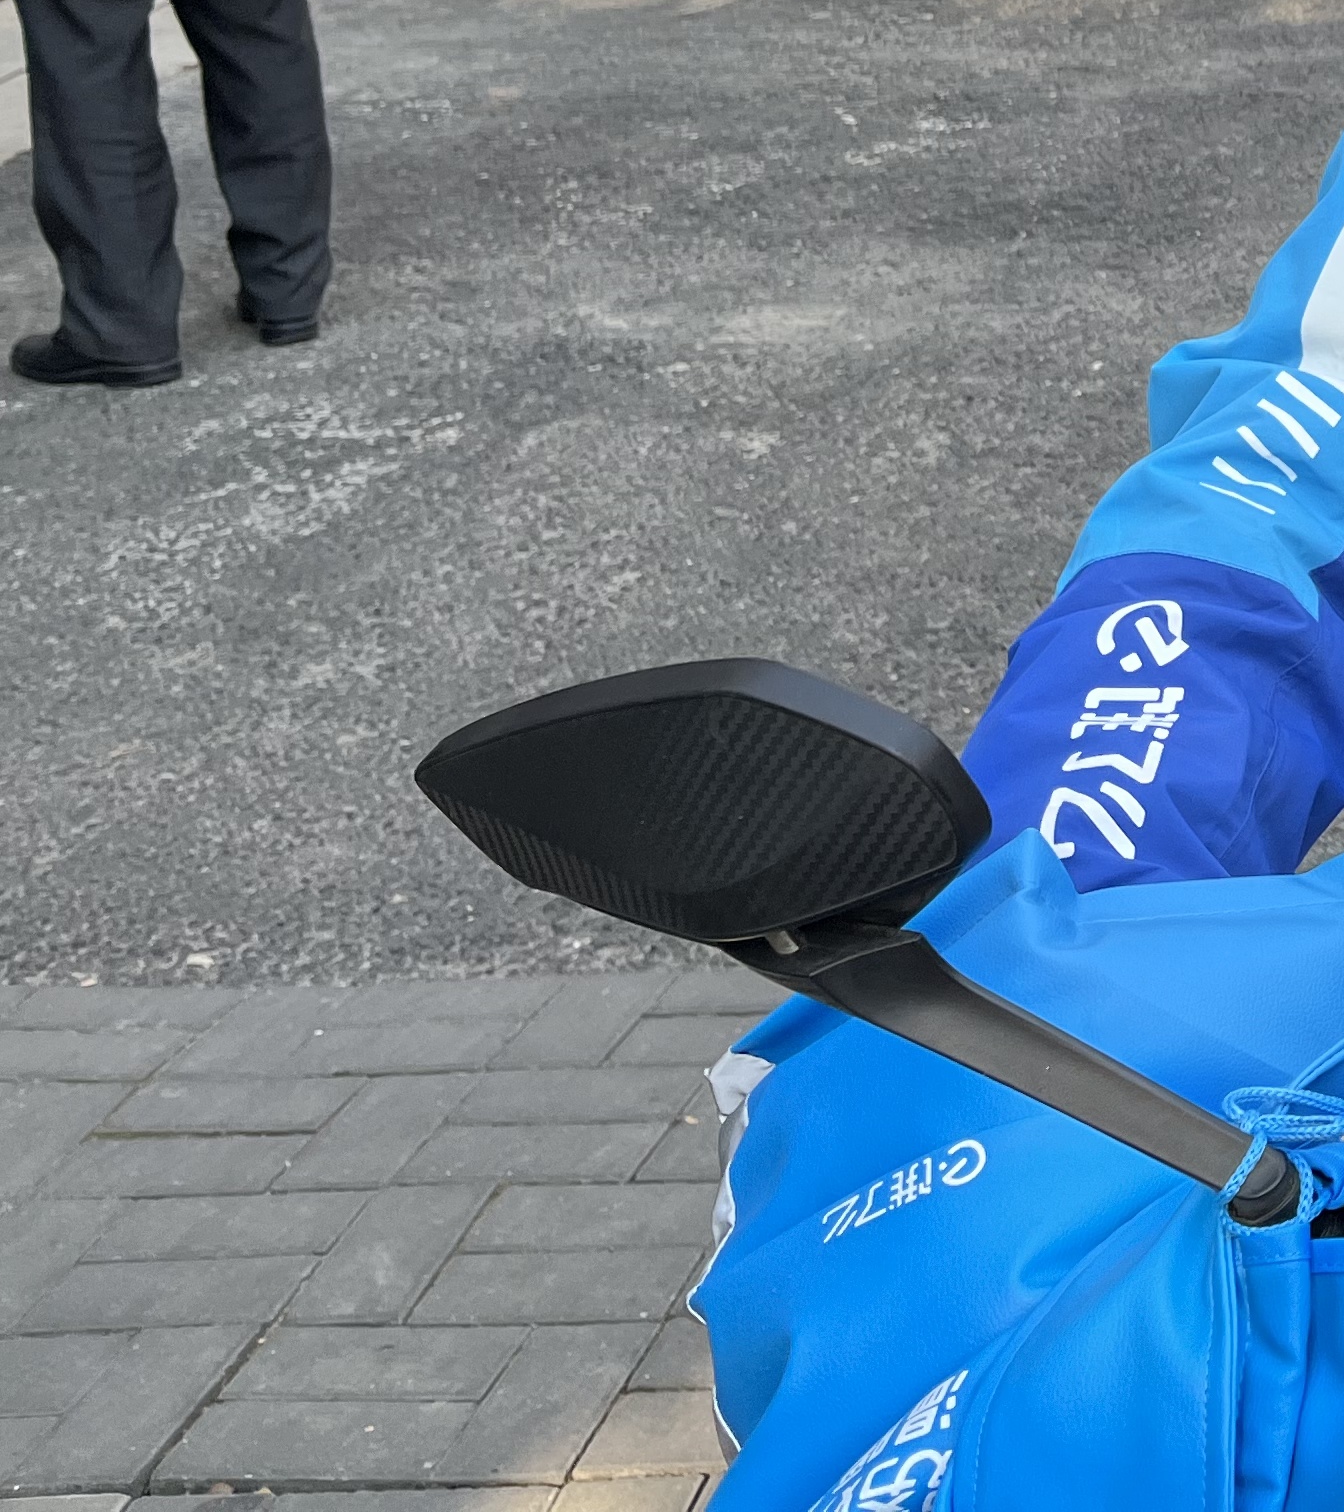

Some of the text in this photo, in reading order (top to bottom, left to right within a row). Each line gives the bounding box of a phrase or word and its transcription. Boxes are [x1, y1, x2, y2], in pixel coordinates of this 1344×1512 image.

[1039, 686, 1185, 861] 饿了么
[822, 1157, 932, 1244] 饿了么
